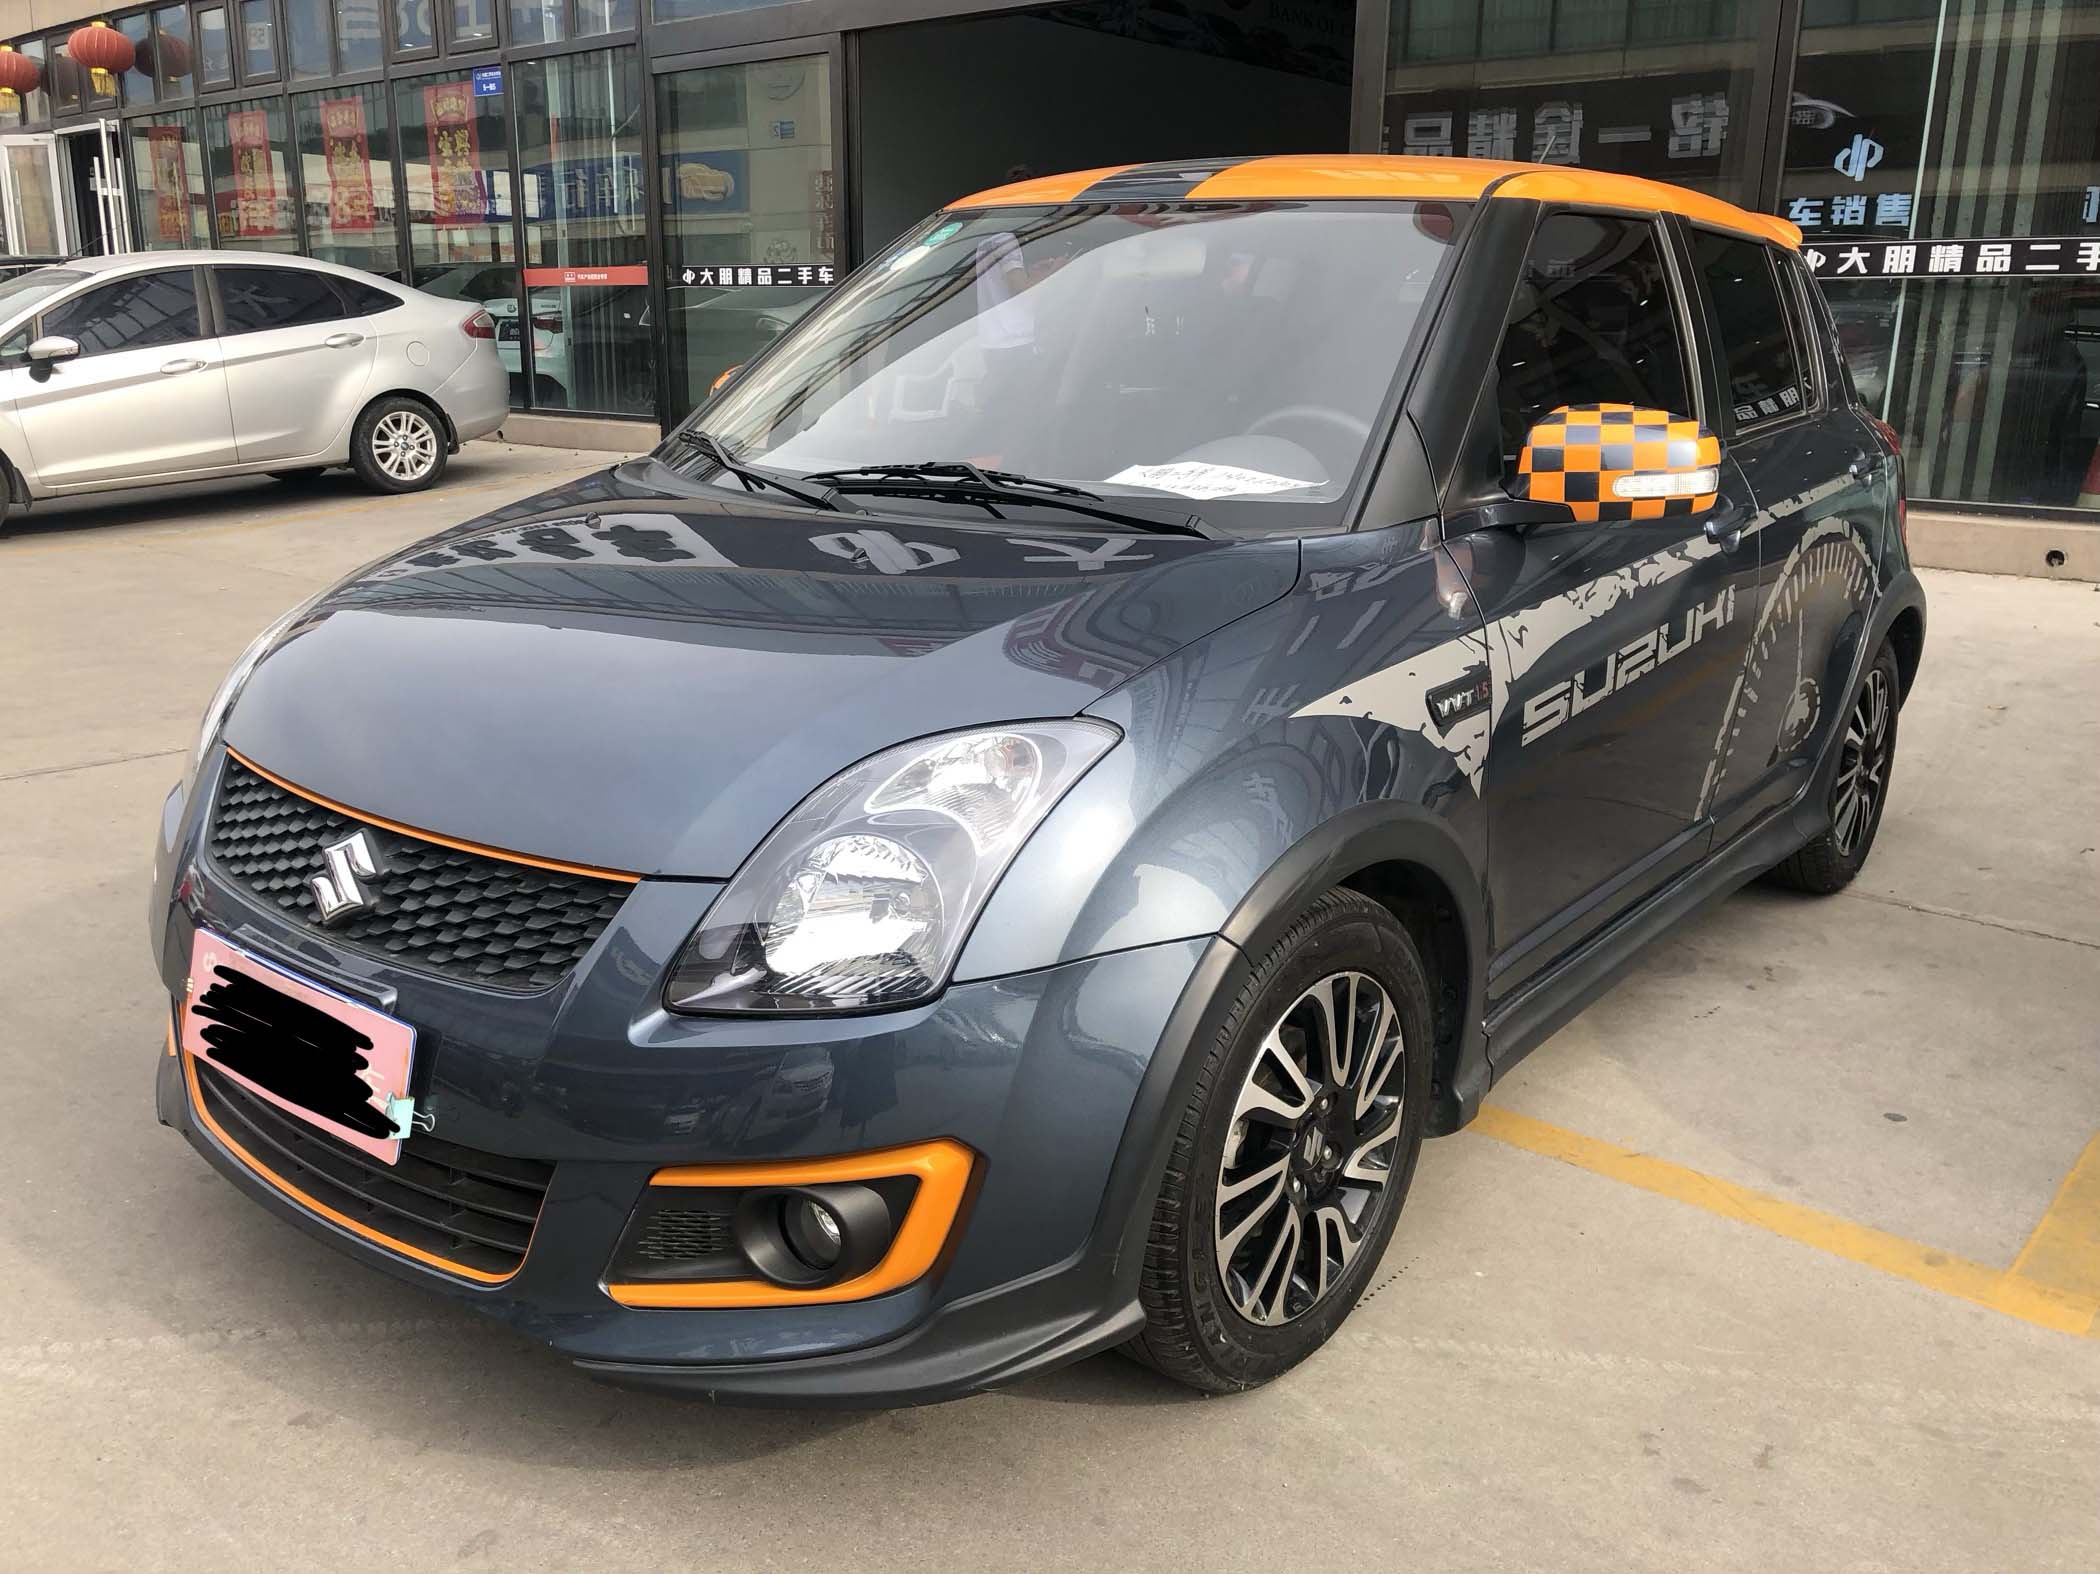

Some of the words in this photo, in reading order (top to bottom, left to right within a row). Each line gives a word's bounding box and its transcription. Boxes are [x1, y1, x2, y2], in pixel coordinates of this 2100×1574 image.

[1788, 193, 1912, 227] 车销售
[699, 266, 834, 286] 大朋精品二手车
[1436, 689, 1474, 718] VVT
